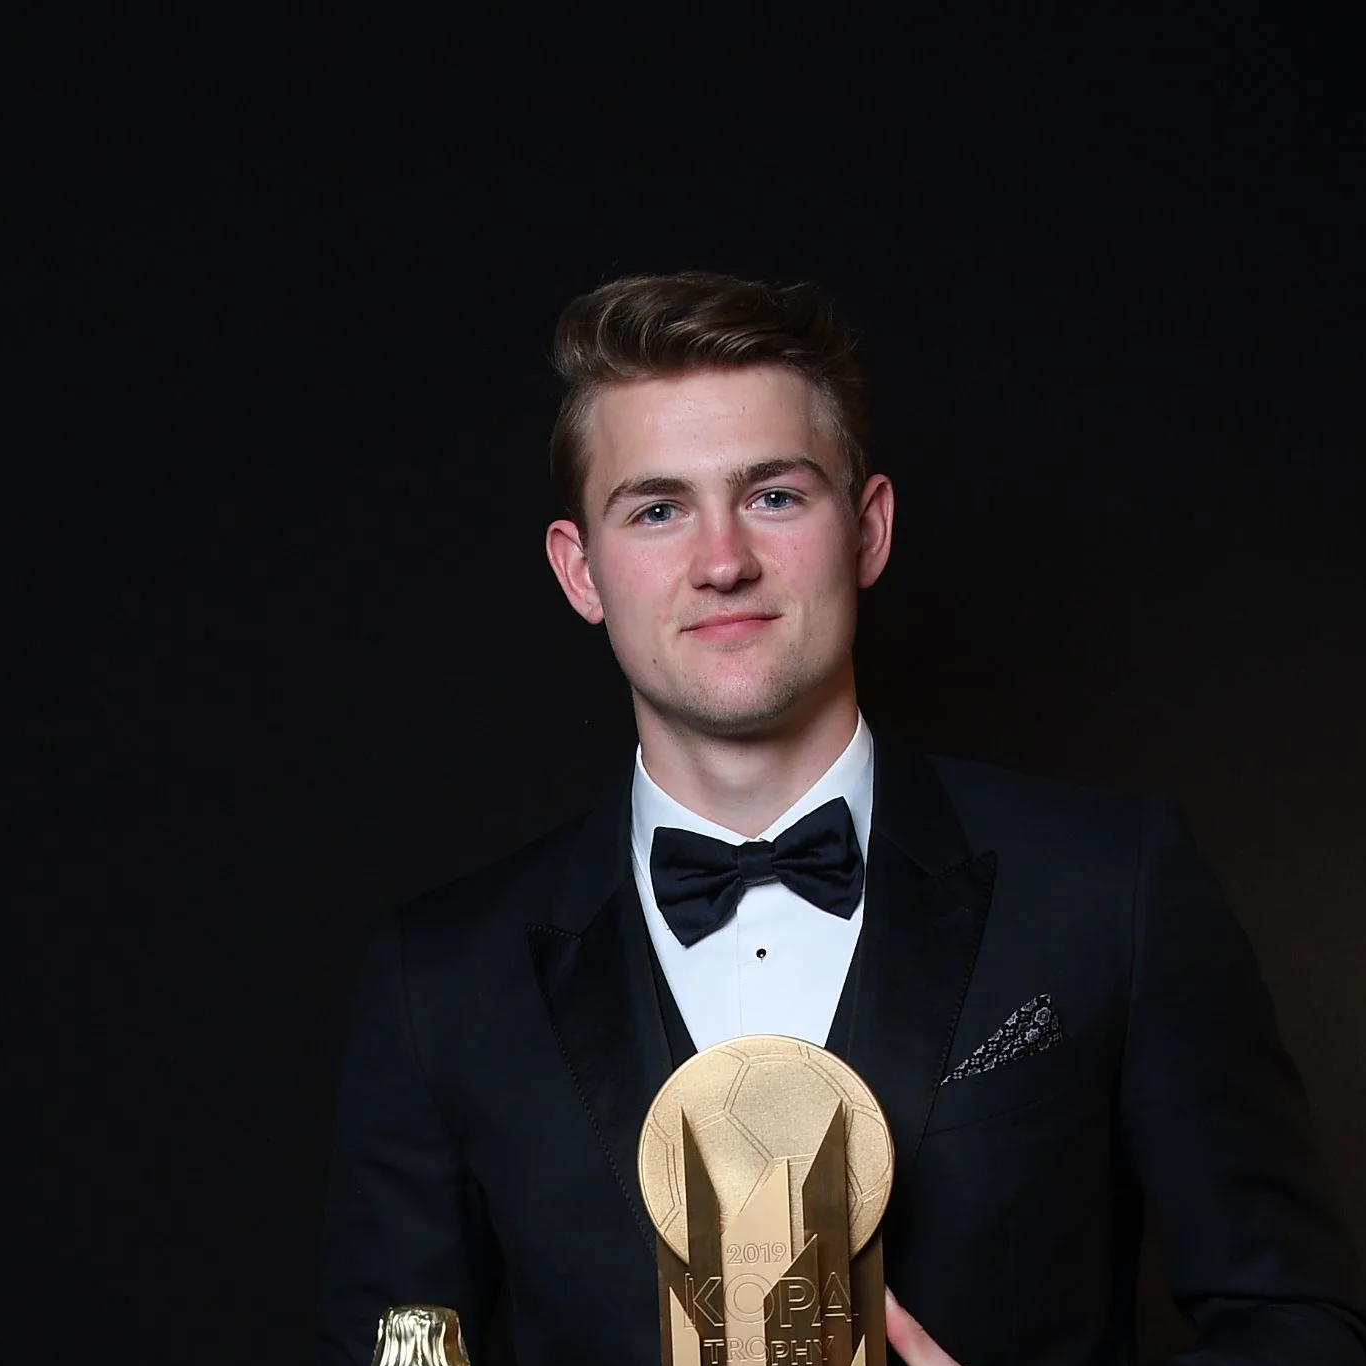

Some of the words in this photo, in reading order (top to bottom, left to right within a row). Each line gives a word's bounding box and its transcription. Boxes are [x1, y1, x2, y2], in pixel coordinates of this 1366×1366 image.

[726, 1242, 787, 1265] 2019
[684, 1271, 853, 1329] KOPA
[703, 1336, 835, 1366] TROPHY
